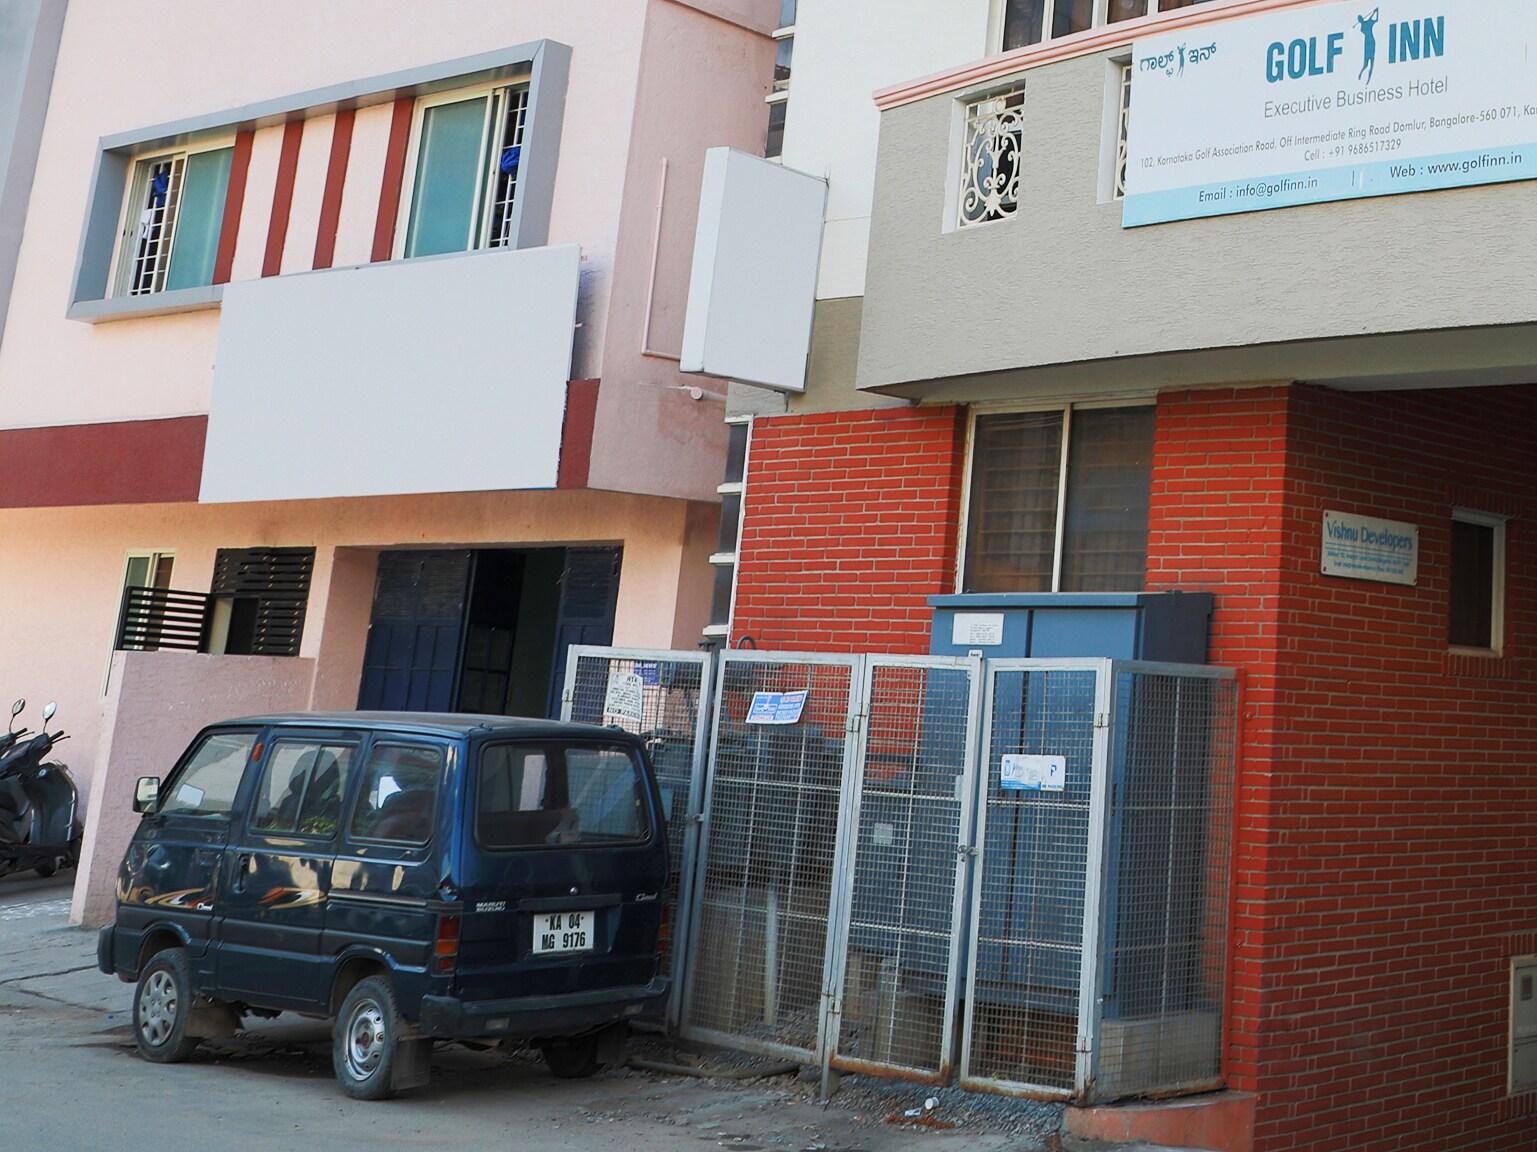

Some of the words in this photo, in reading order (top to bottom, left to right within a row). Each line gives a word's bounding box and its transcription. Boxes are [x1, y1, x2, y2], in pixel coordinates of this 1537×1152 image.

[1188, 42, 1217, 64] ಇನ್
[1265, 31, 1344, 84] GOLF
[1388, 15, 1445, 64] INN
[1264, 94, 1332, 118] Executive
[1336, 86, 1403, 108] Business
[1408, 76, 1448, 98] Hotel
[1140, 157, 1155, 168] 102,
[1157, 152, 1193, 166] Karnataka
[1195, 147, 1211, 160] Golf
[1212, 141, 1254, 157] Association
[1255, 138, 1277, 151] Road,
[1279, 135, 1293, 148] Off
[1294, 129, 1346, 146] Intermediate
[1348, 126, 1367, 139] Ring
[1369, 122, 1391, 136] Road
[1393, 119, 1427, 133] Domlur,
[1429, 109, 1497, 129] Bangalore-560
[1500, 106, 1521, 119] 071,
[1303, 148, 1320, 161] Cell
[1328, 145, 1345, 158] +91
[1347, 138, 1401, 156] 9686517329
[1389, 164, 1416, 179] Web
[1427, 151, 1522, 174] www.golfinn.in
[1198, 187, 1227, 203] Email
[1235, 176, 1318, 197] info@golfinn.in
[1326, 520, 1359, 542] Vishnu
[1360, 525, 1413, 552] Developers
[1050, 764, 1058, 777] P
[549, 914, 562, 931] KA
[568, 913, 581, 929] 04
[541, 934, 555, 950] MG
[562, 932, 586, 948] 9176
